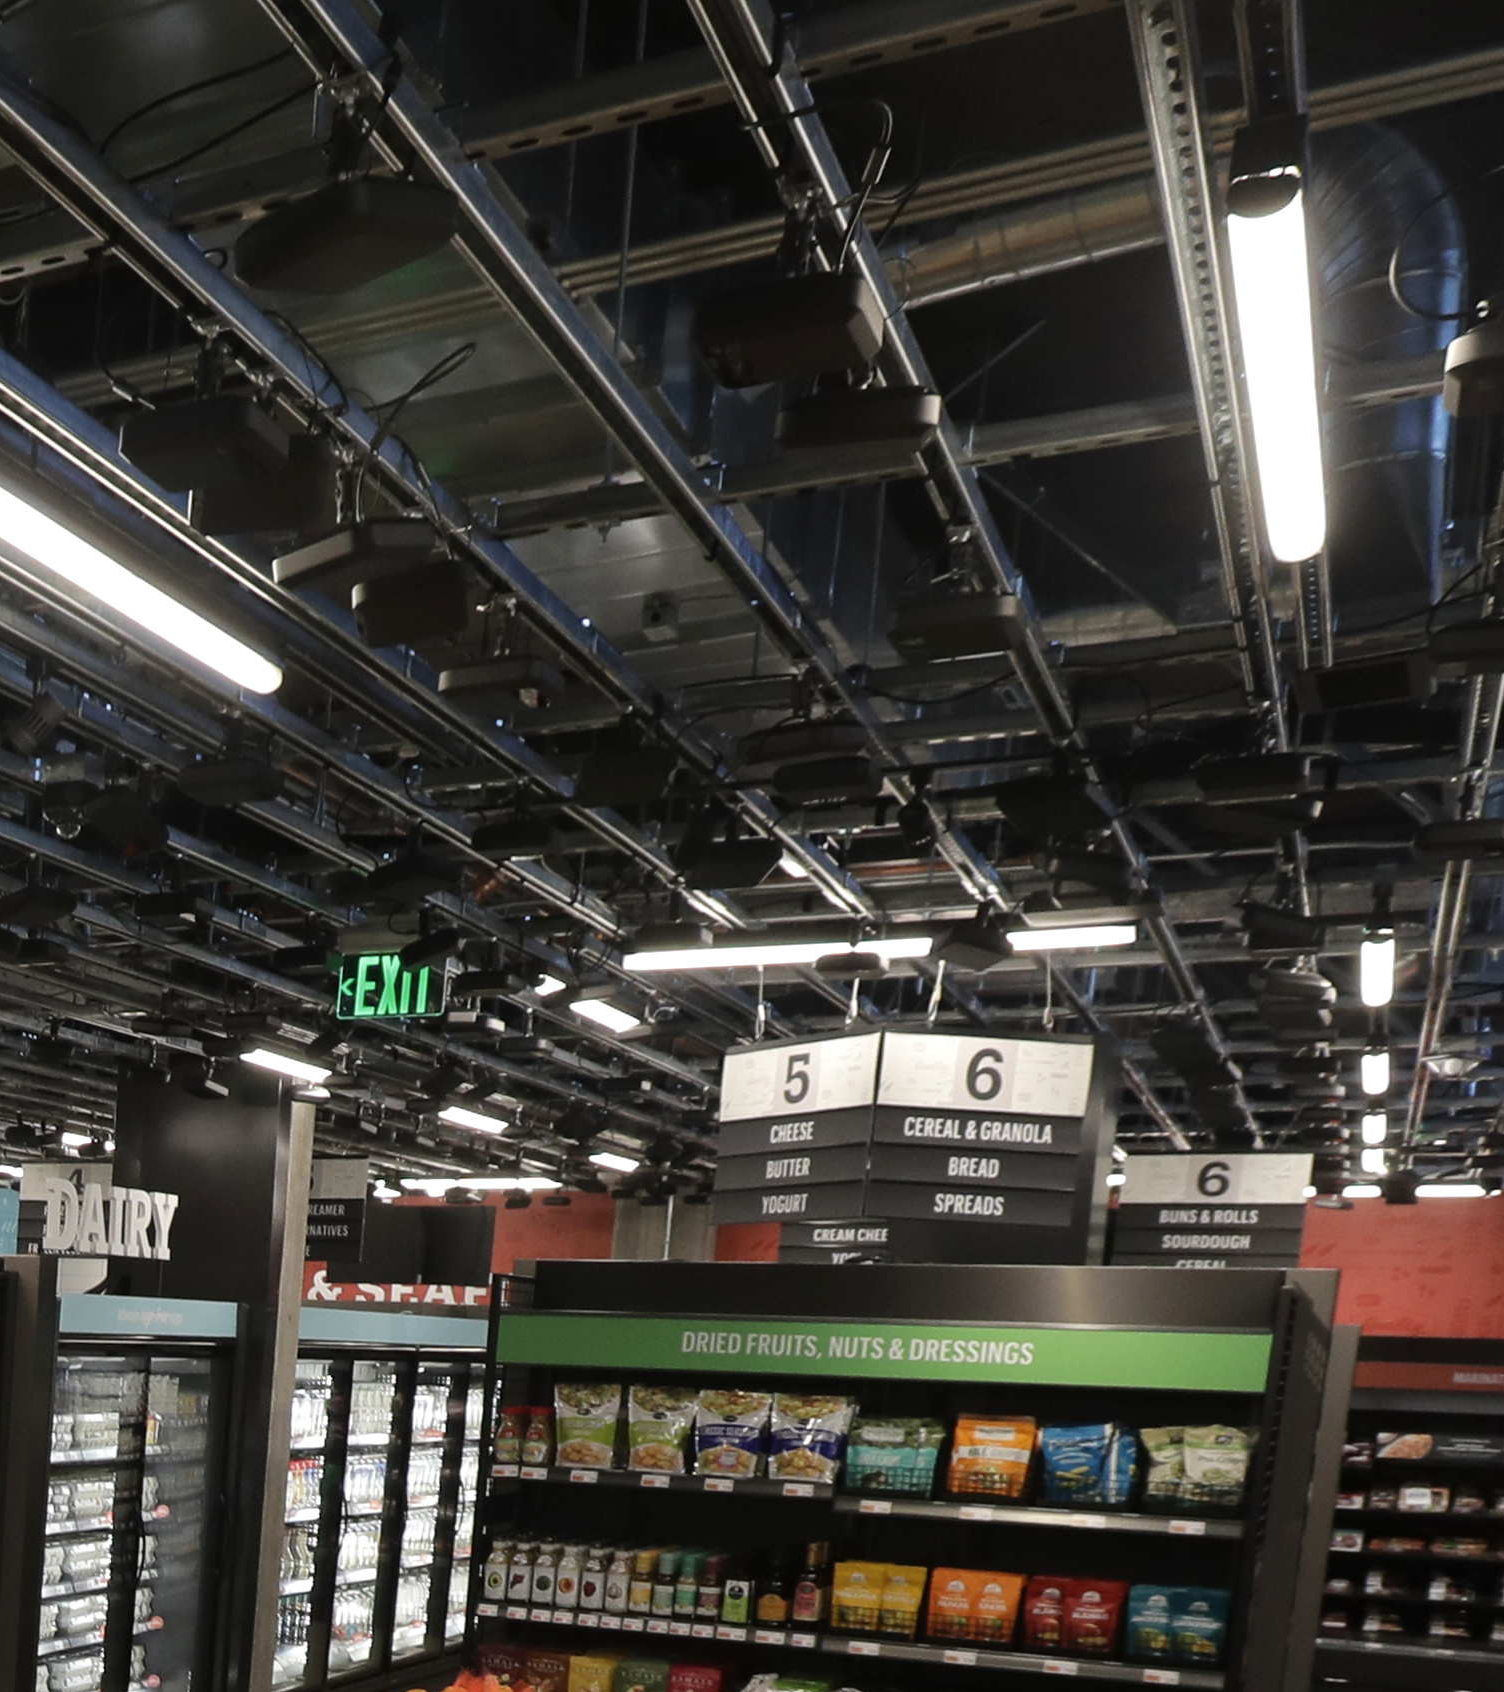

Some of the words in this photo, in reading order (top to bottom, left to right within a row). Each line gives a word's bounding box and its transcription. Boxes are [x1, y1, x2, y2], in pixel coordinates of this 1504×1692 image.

[784, 1053, 811, 1105] 5
[966, 1047, 1005, 1101] 6
[769, 1121, 815, 1145] CHEESE
[903, 1116, 962, 1140] CEREAL
[965, 1121, 977, 1141] &
[980, 1121, 1053, 1145] GRANOLA
[765, 1157, 811, 1180] BUTTER
[947, 1156, 1001, 1179] BREAD
[1197, 1161, 1231, 1197] 6
[761, 1193, 809, 1215] YOGURT
[933, 1192, 1005, 1216] SPREADS
[42, 1177, 179, 1261] DAIRY
[1159, 1209, 1198, 1224] BUNS
[1199, 1209, 1211, 1224] &
[1213, 1209, 1260, 1224] ROLLS
[813, 1228, 855, 1242] CREAM
[1161, 1234, 1251, 1249] SOURDOUGH
[681, 1331, 743, 1355] DRIED
[745, 1333, 823, 1360] FRUITS,
[828, 1336, 885, 1360] NUTS
[887, 1337, 905, 1361] &
[908, 1338, 1035, 1366] DRESSINGS
